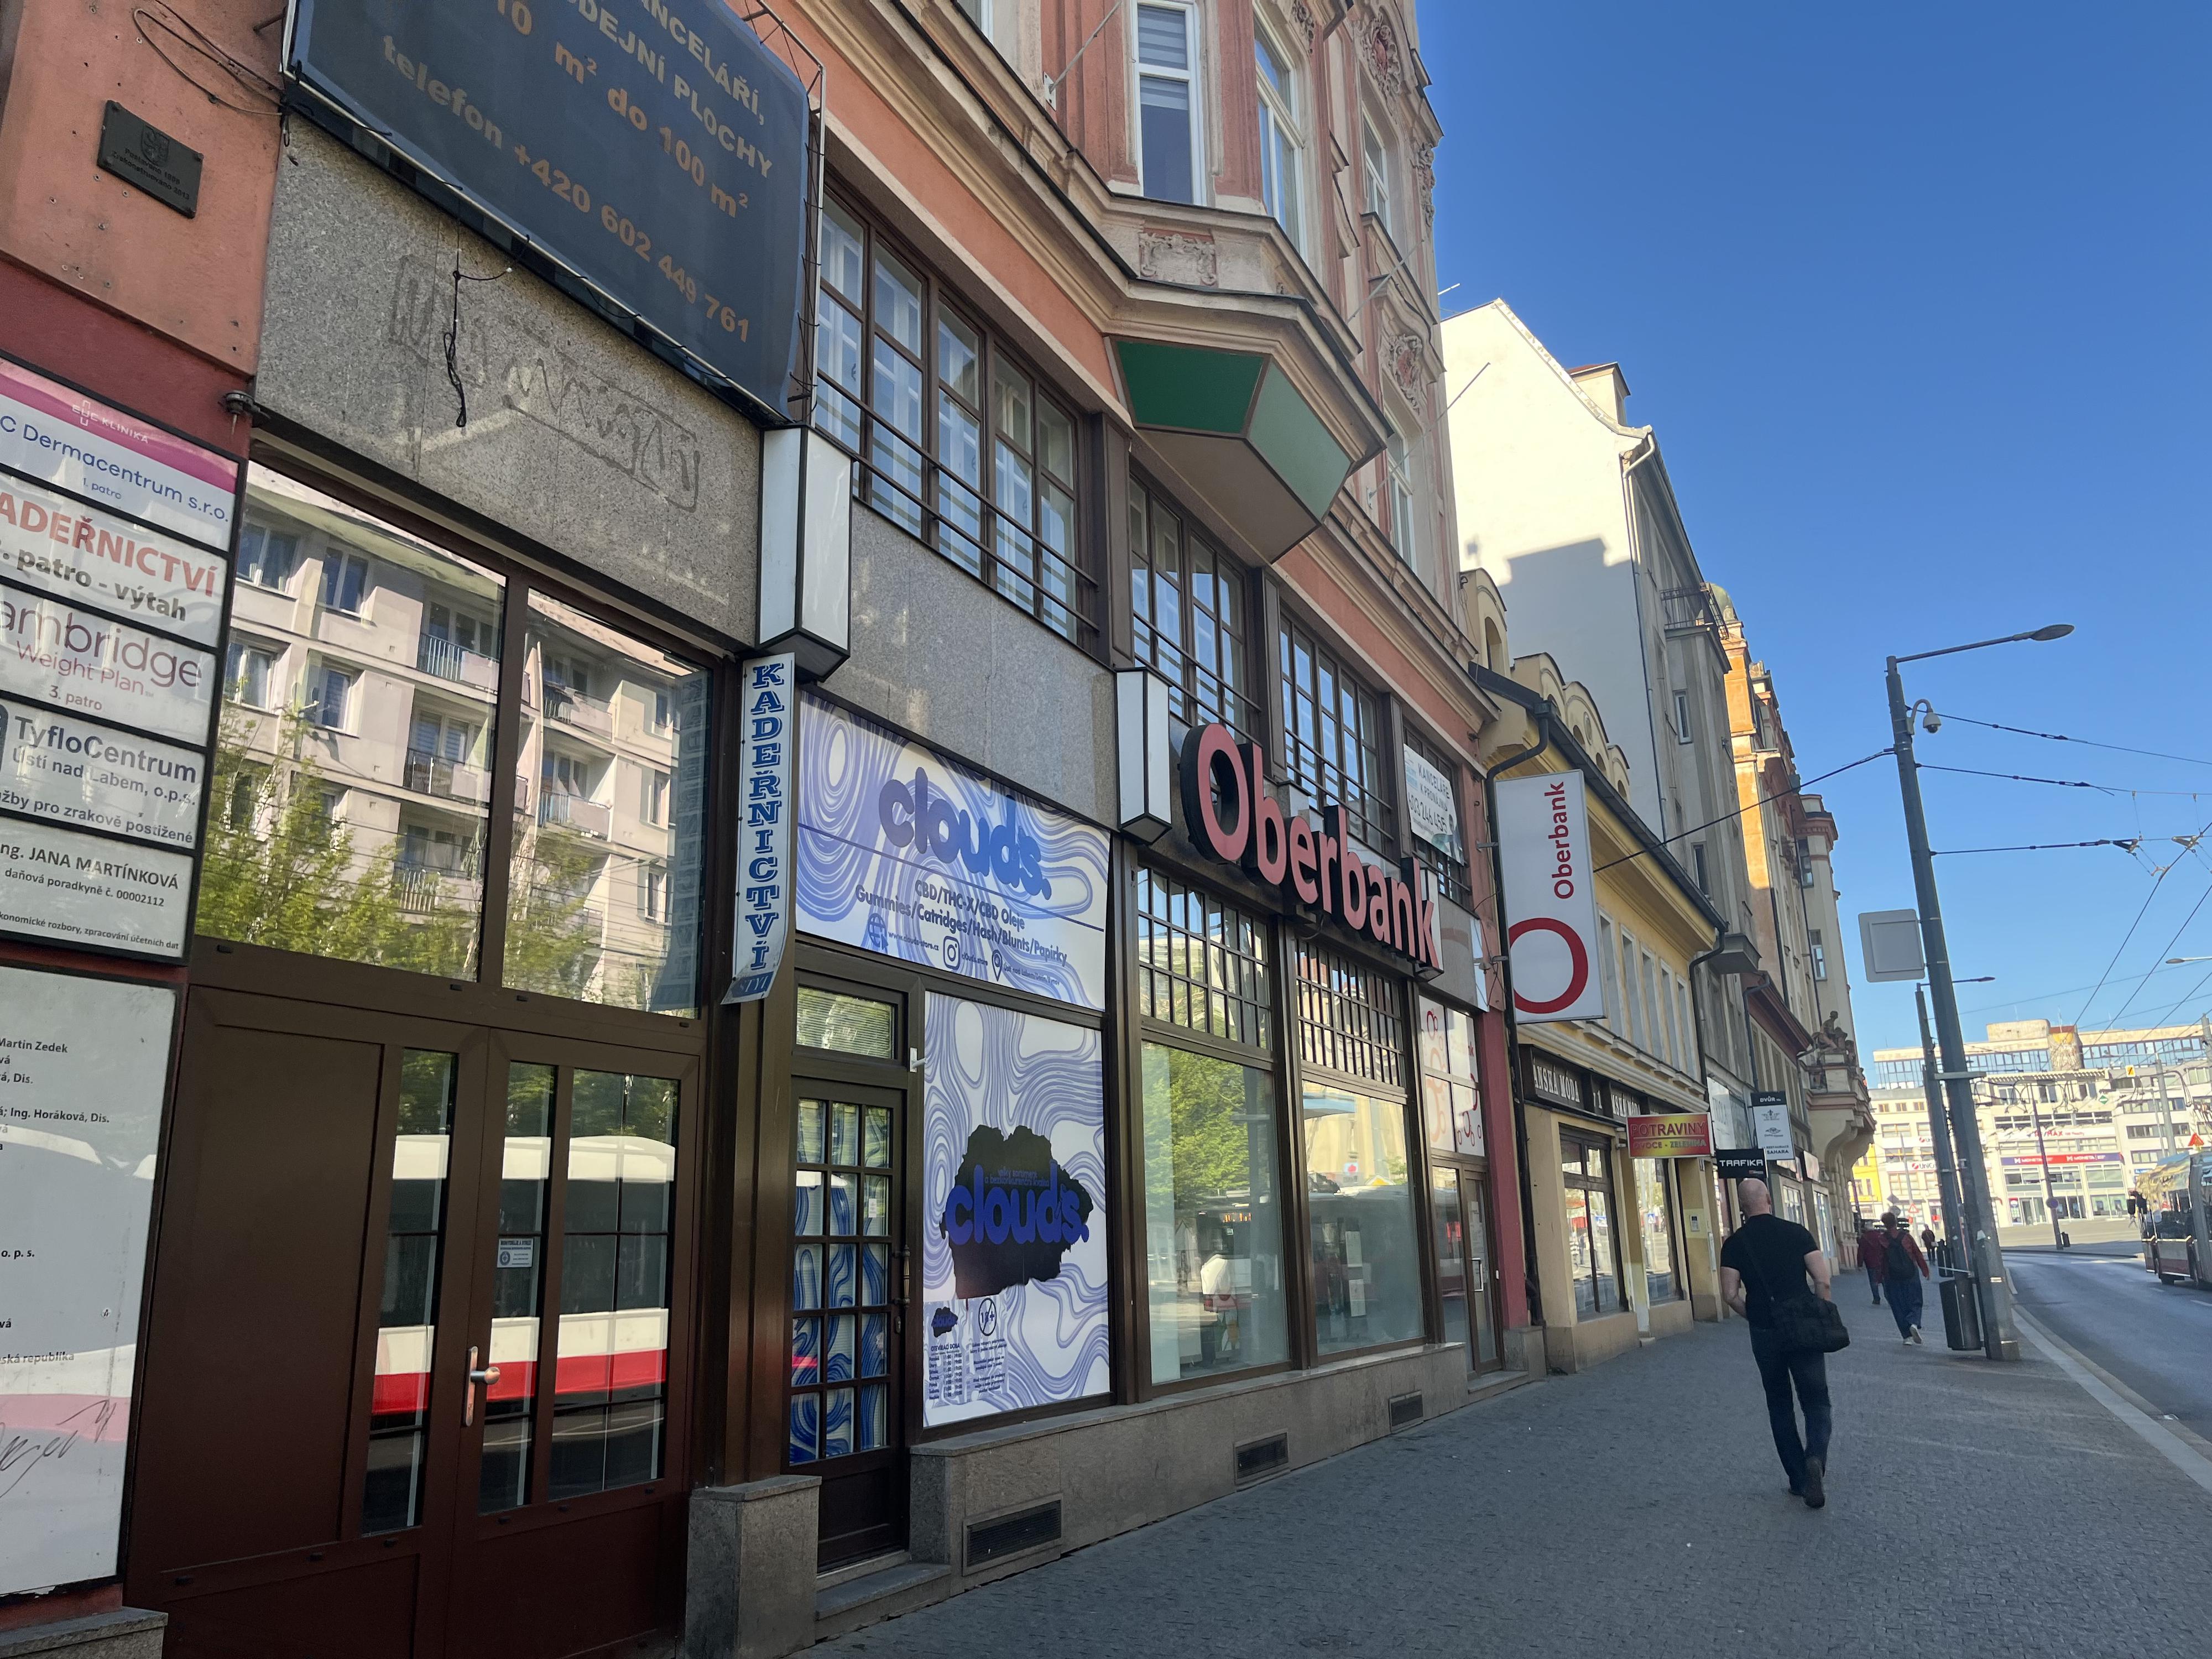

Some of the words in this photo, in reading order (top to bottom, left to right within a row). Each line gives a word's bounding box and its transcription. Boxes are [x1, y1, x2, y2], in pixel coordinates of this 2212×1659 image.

[568, 0, 666, 86] DEJNÍ
[674, 74, 773, 178] PLOCHY
[607, 86, 648, 132] do
[660, 125, 706, 186] 100
[382, 35, 503, 149] telefon
[514, 144, 591, 215] +420
[601, 204, 652, 263] 602
[658, 254, 697, 304] 449
[705, 293, 750, 344] 761
[101, 418, 150, 444] KLINIKA
[23, 423, 183, 503] Dermacentrum
[188, 495, 229, 523] s.r.o.
[82, 477, 89, 487] 1.
[91, 482, 122, 500] patro
[17, 549, 92, 587] patro
[114, 582, 187, 622] výtah
[17, 640, 93, 681] Weight
[101, 667, 144, 696] Plan
[49, 685, 61, 700] 3.
[66, 692, 103, 711] patro
[14, 715, 197, 784] TyfloCentrum
[13, 745, 48, 770] Ústí
[53, 761, 85, 779] nad
[88, 766, 149, 796] Labem,
[154, 786, 196, 806] o.p.s.
[0, 790, 29, 810] žby
[34, 798, 60, 814] pro
[64, 805, 122, 828] zrakově
[126, 817, 193, 844] postižené
[745, 662, 784, 972] KADEŘNICTVÍ
[1408, 791, 1421, 816] 603
[1421, 801, 1433, 826] 246
[1434, 811, 1448, 834] 455
[1183, 723, 1440, 969] Oberbank
[1544, 781, 1574, 900] Oberbank
[4, 868, 45, 885] daňová
[47, 877, 103, 896] poradkyně
[105, 886, 114, 898] č.
[116, 889, 165, 907] 00002112
[29, 847, 71, 869] JANA
[76, 855, 179, 890] MARTÍNKOVÁ
[855, 884, 1068, 967] Gummies/Catridges/Hash/Blunts/Papirky
[915, 879, 999, 919] CBD/THC-X/CBD
[1001, 911, 1025, 930] Oleje
[48, 921, 83, 935] rozbory,
[84, 927, 130, 942] zpracování
[131, 932, 165, 948] účetních
[165, 939, 179, 950] dat
[0, 1037, 33, 1050] Martin
[35, 1041, 68, 1053] Zedek
[13, 1073, 34, 1084] Dis.
[1559, 1070, 1580, 1103] MÓDA
[10, 1107, 31, 1120] Ing.
[34, 1109, 88, 1123] Horáková,
[90, 1113, 110, 1124] Dis.
[1630, 1121, 1705, 1136] POTRAVINY
[23, 1351, 75, 1365] republika
